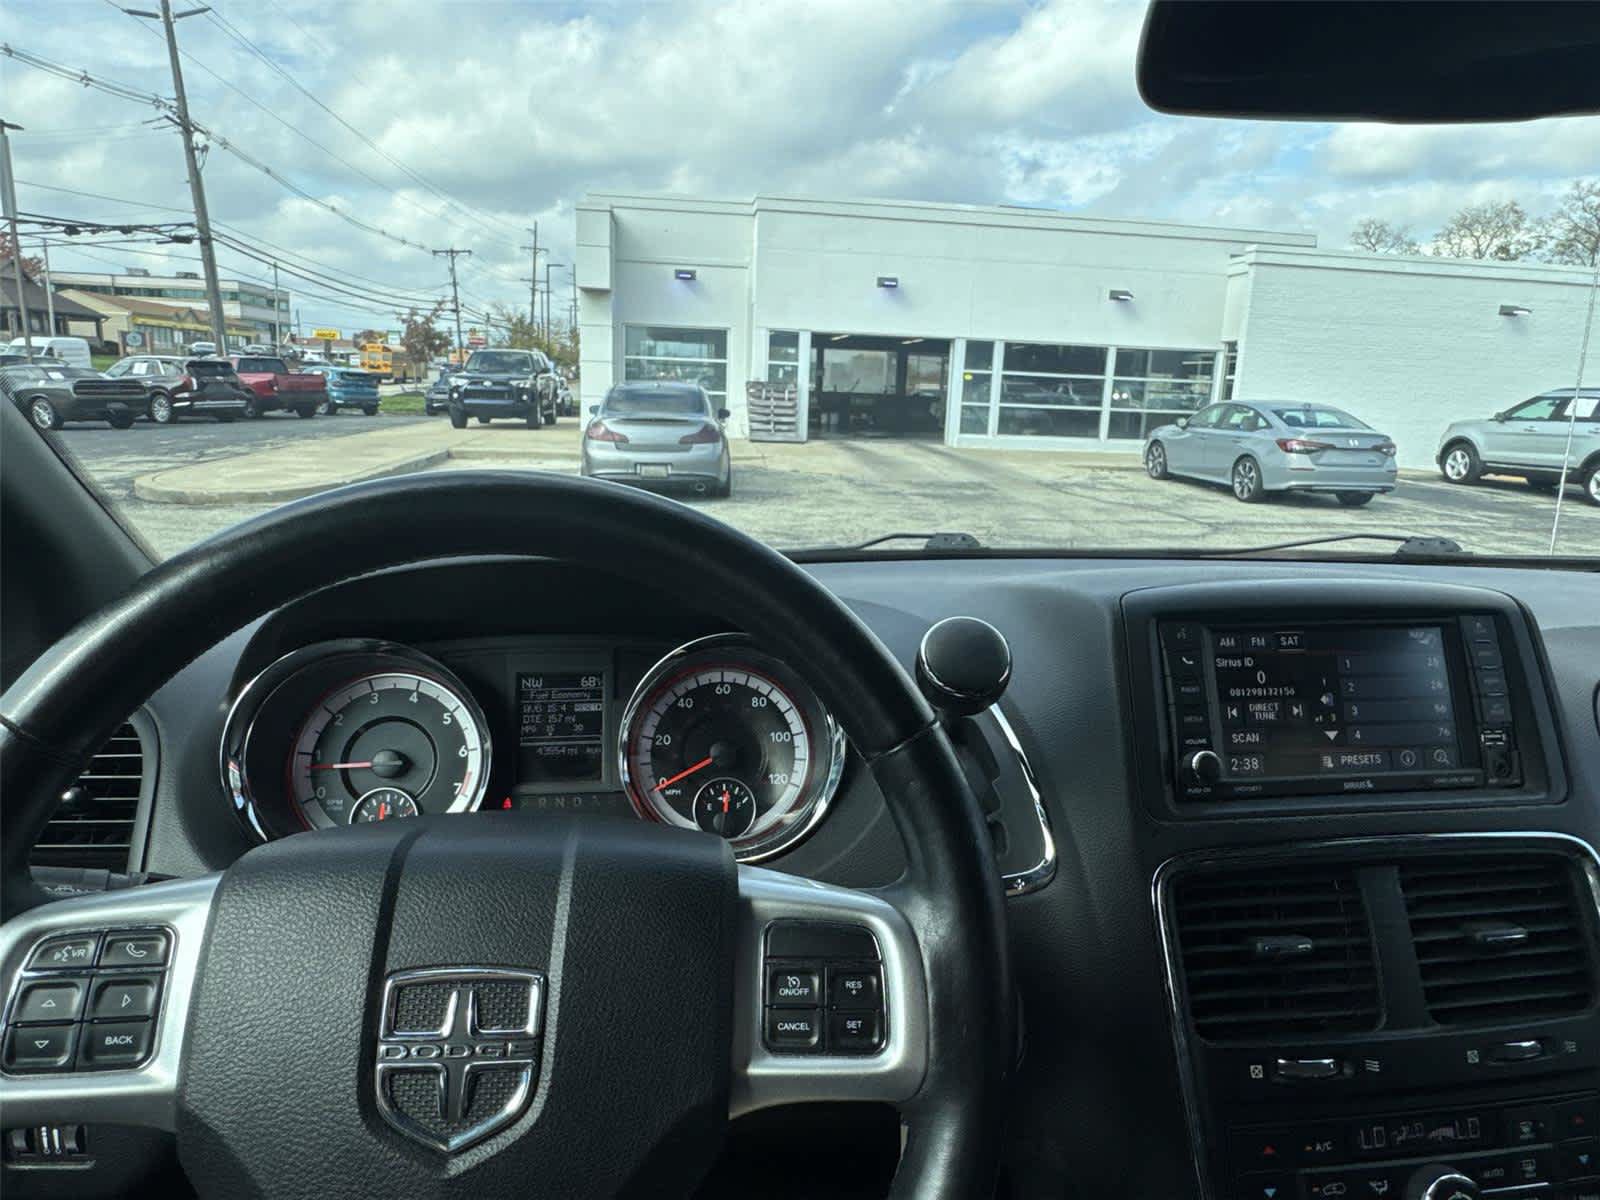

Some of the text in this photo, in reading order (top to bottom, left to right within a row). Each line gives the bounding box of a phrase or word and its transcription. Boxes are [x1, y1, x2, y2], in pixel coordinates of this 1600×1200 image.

[1250, 636, 1266, 647] FM
[1279, 636, 1299, 647] SAT
[1215, 656, 1254, 668] Sirius ID
[521, 677, 543, 690] NW
[714, 684, 731, 695] 60
[368, 692, 380, 705] 3
[408, 691, 419, 704] 4
[677, 697, 694, 709] 40
[751, 697, 767, 708] 80
[1249, 702, 1279, 713] DIRECT
[334, 713, 345, 727] 2
[442, 712, 453, 725] 5
[1254, 711, 1277, 721] TUNE
[655, 734, 672, 746] 20
[769, 731, 792, 743] 100
[1231, 733, 1260, 745] SCAN
[458, 745, 468, 758] 6
[1231, 757, 1260, 771] 2:38
[1340, 753, 1383, 766] PRESETS
[768, 773, 789, 785] 120
[316, 785, 326, 799] 0
[453, 782, 464, 796] 7
[664, 788, 682, 797] MPH
[71, 948, 87, 958] VR
[778, 986, 810, 998] ON/OFF
[845, 981, 863, 991] RES
[776, 1021, 811, 1032] CANCEL
[846, 1019, 863, 1030] SET
[105, 1034, 134, 1046] BACK
[379, 1041, 537, 1060] DODGE
